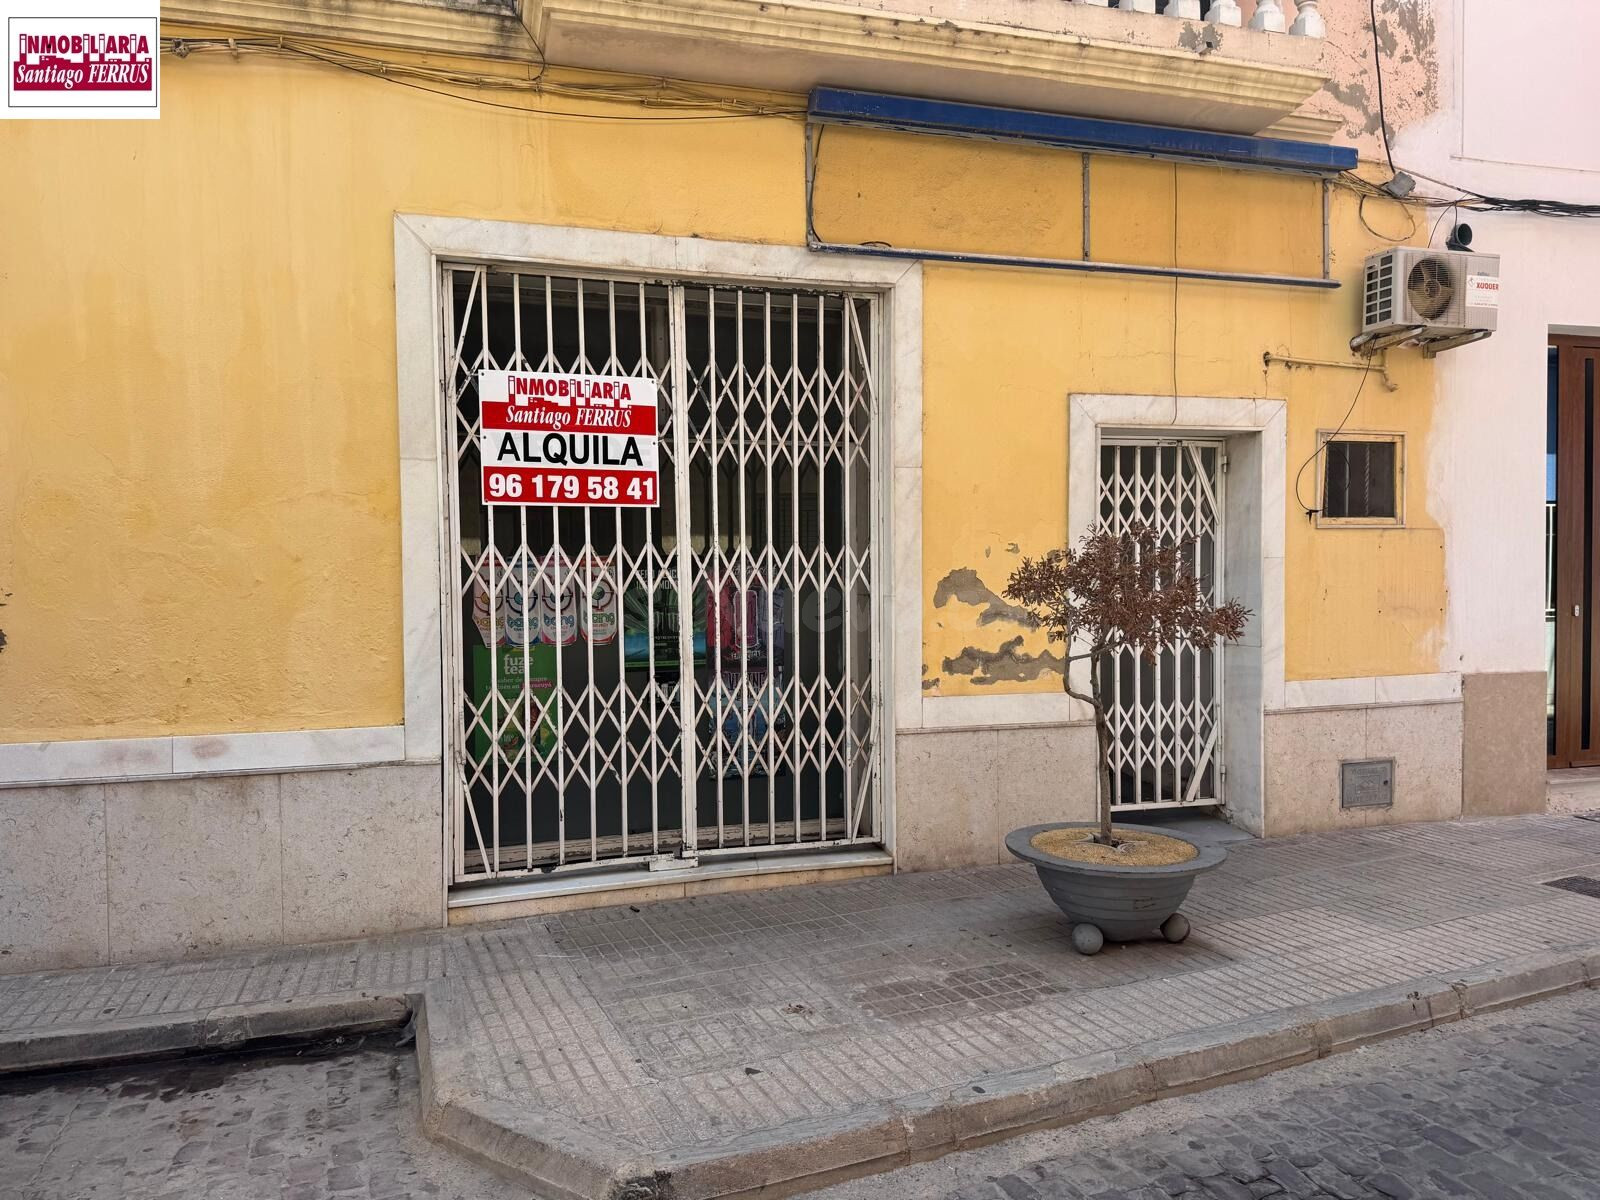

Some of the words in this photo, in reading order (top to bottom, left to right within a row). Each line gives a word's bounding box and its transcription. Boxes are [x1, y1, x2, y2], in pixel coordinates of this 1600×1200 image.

[508, 375, 632, 401] INMOBILIARIA
[505, 405, 571, 430] Santiago
[575, 407, 632, 428] FERRUS
[497, 431, 644, 467] ALQUILA
[489, 473, 523, 498] 96
[531, 474, 580, 499] 179
[587, 476, 619, 500] 58
[626, 477, 654, 500] 41
